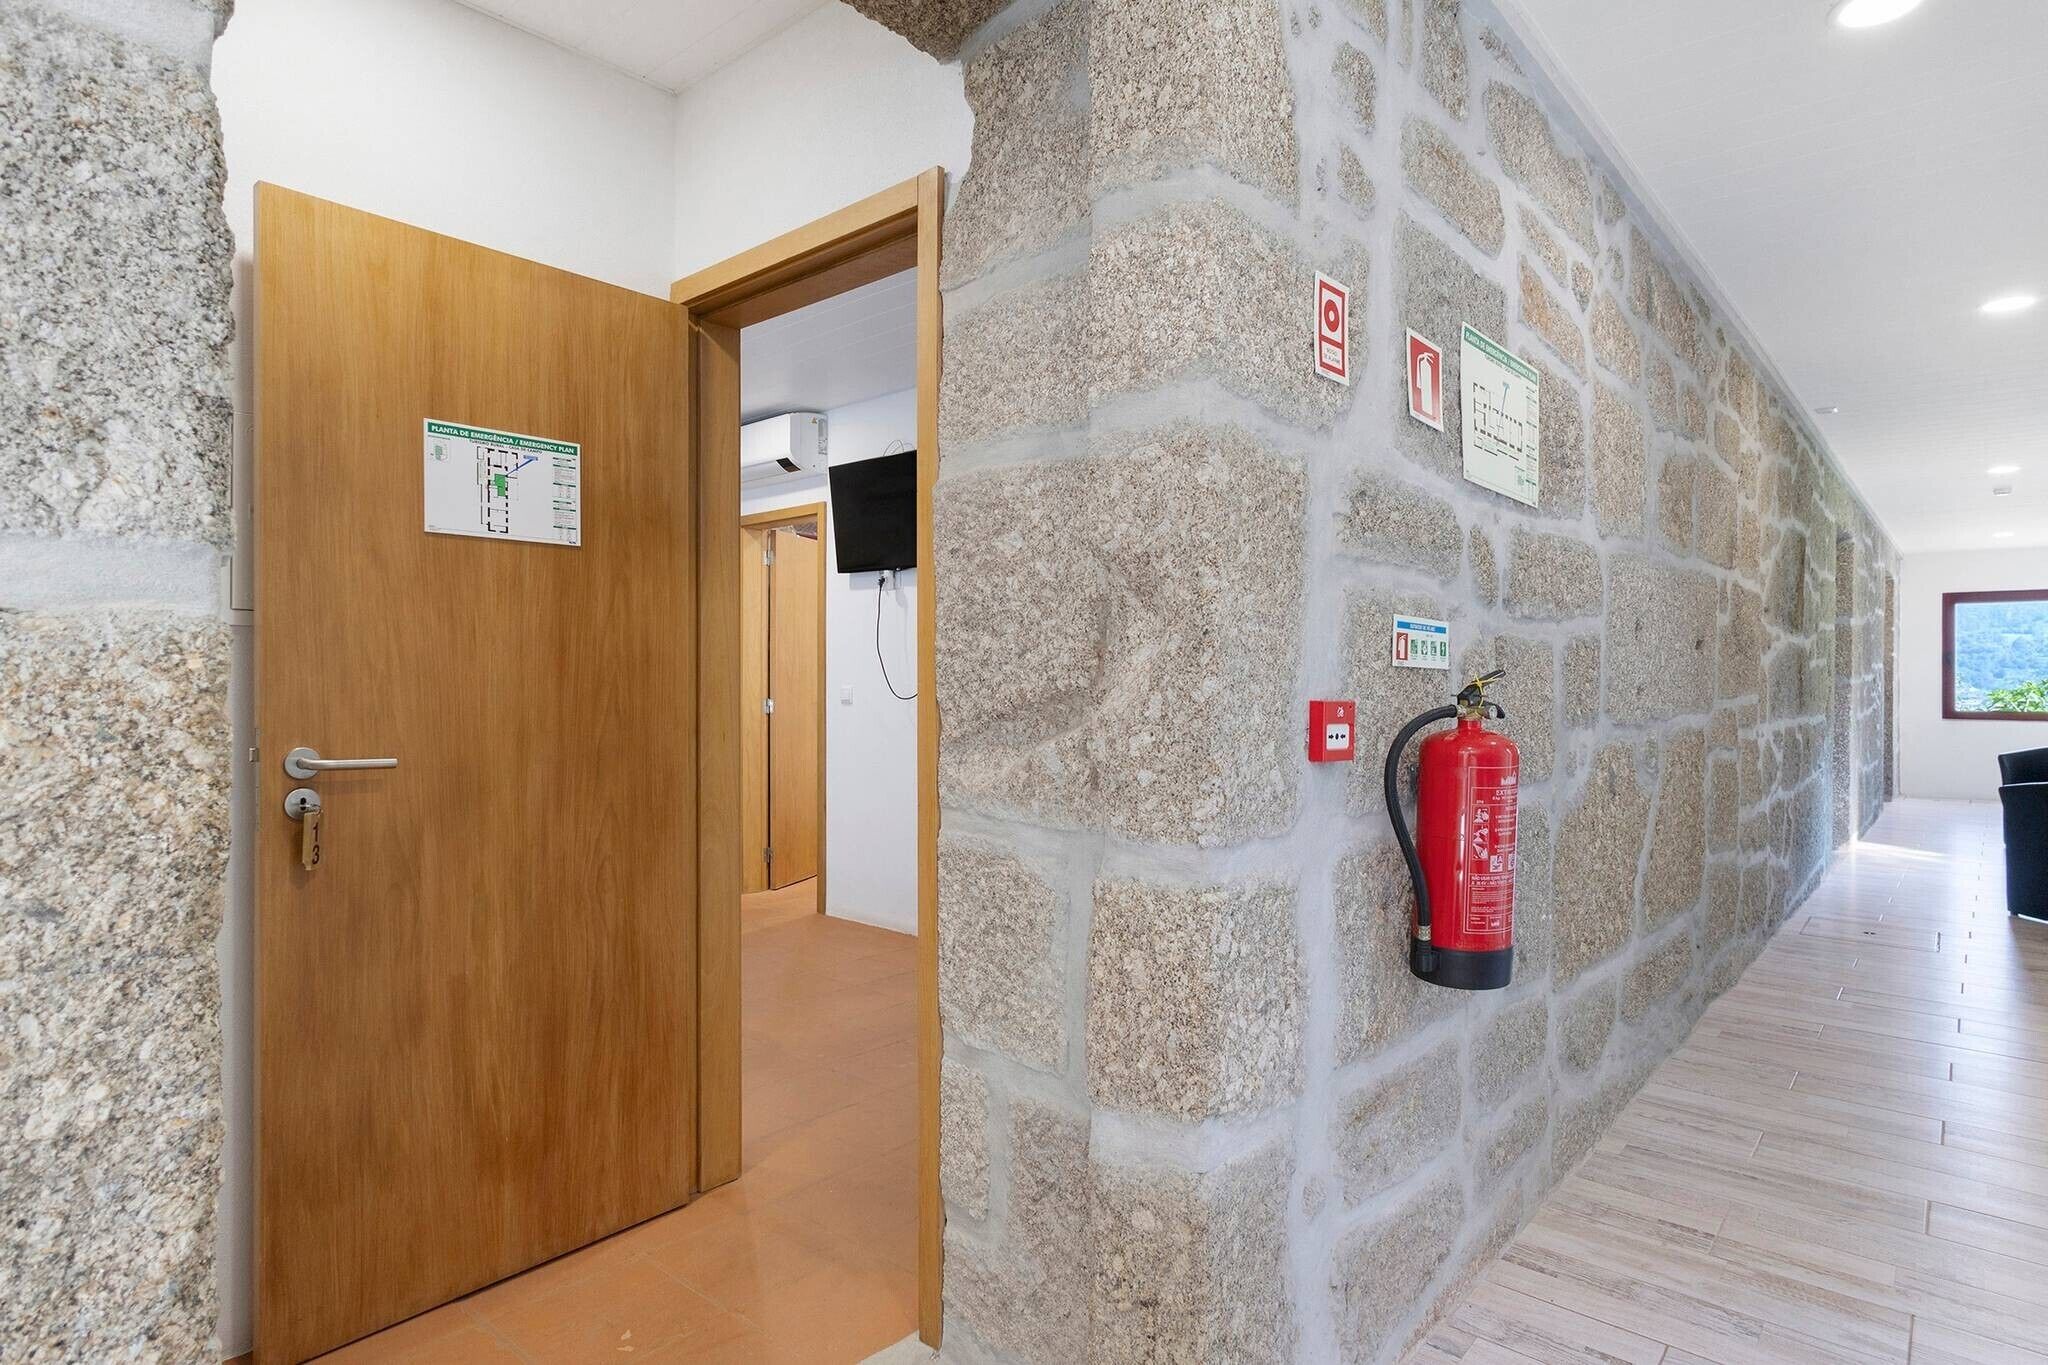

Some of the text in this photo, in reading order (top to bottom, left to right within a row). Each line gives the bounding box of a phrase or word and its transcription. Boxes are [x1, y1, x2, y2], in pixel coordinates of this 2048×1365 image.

[431, 425, 459, 436] PLANTA
[470, 432, 514, 444] EMERGÊNCIA
[519, 439, 558, 451] EMERGENCY
[558, 446, 575, 454] PLAN
